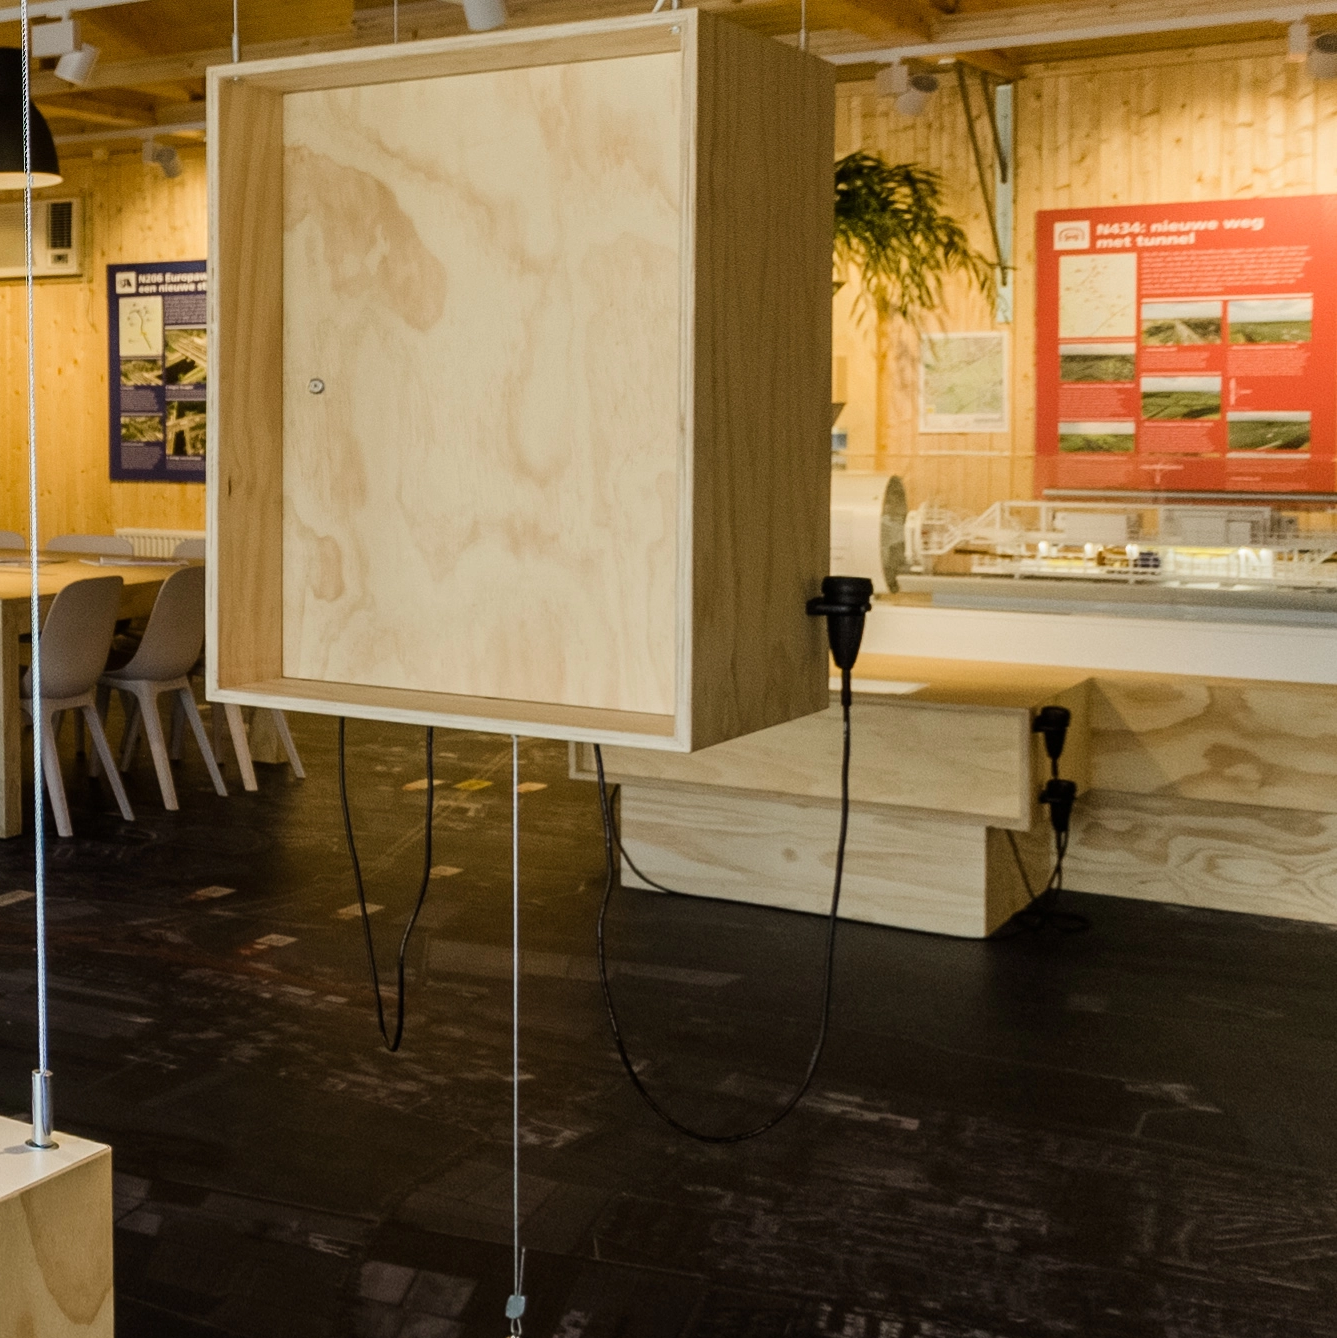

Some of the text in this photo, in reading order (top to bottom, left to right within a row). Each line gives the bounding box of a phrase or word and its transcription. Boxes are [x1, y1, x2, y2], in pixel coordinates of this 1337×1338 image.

[1150, 219, 1218, 233] nieuwe
[1223, 216, 1265, 231] weg
[1096, 232, 1195, 249] met tunnel
[138, 273, 163, 284] N206
[138, 284, 156, 293] een
[158, 283, 195, 292] nieuwe
